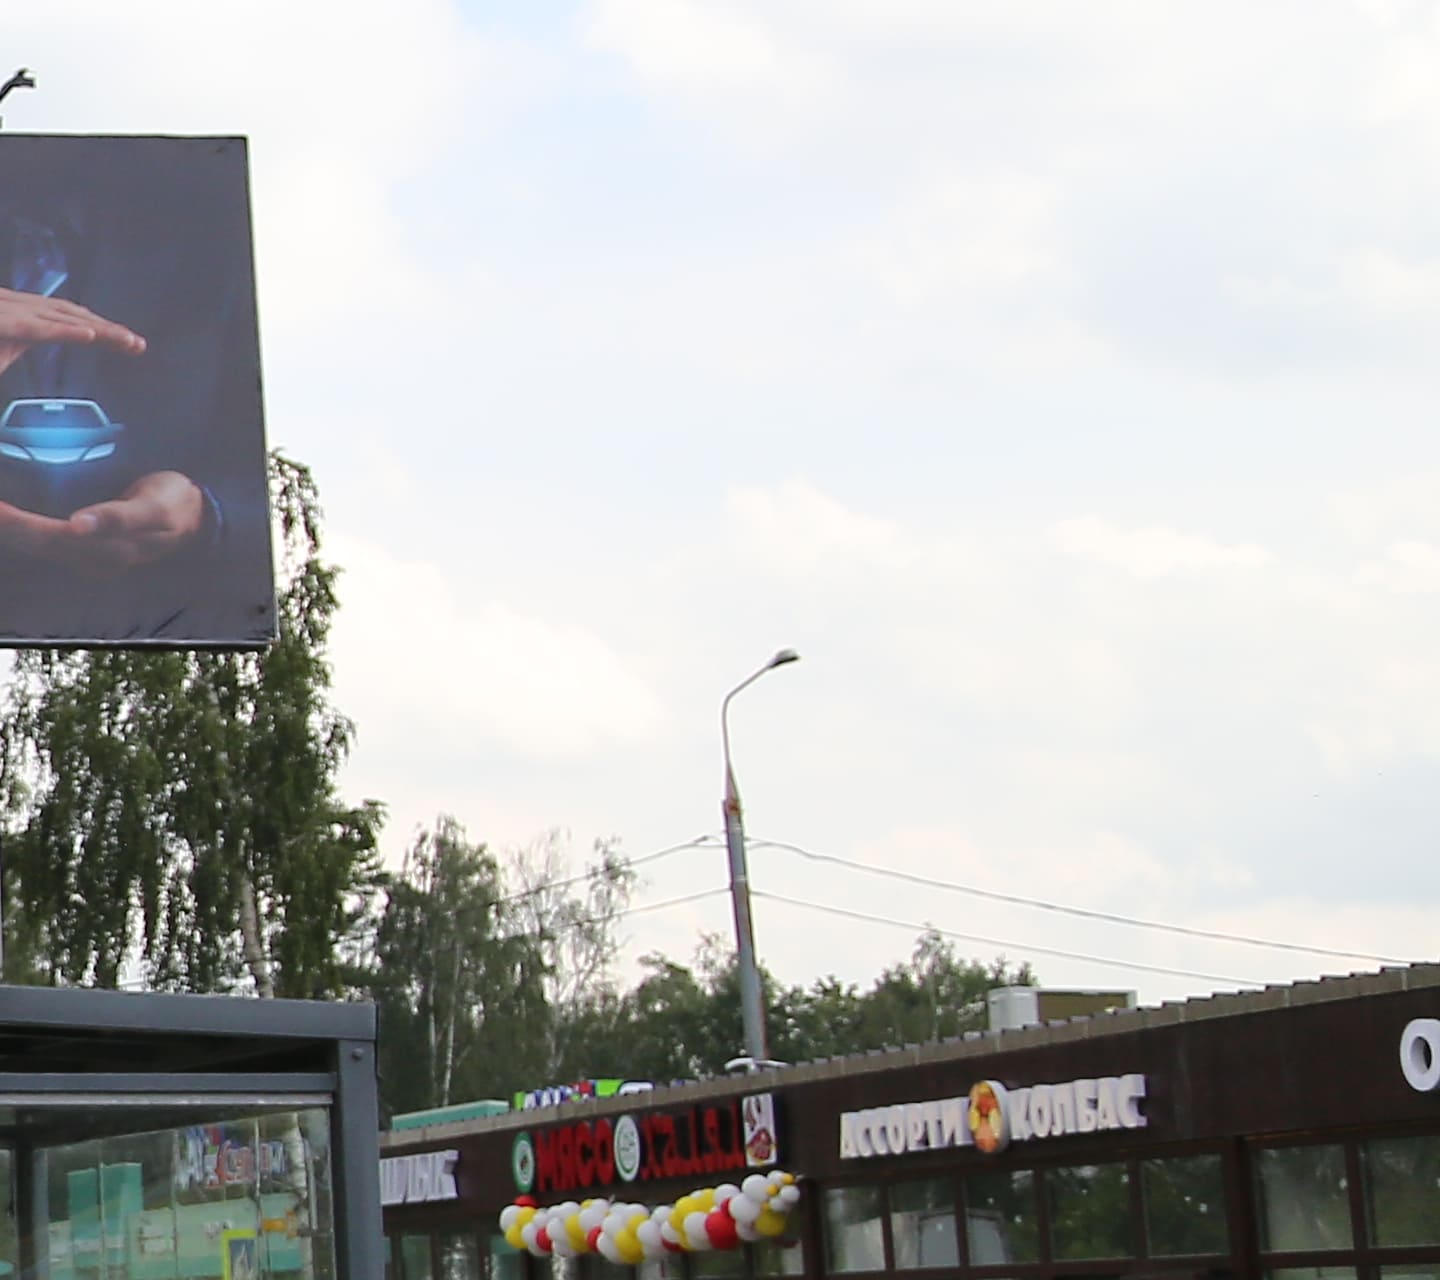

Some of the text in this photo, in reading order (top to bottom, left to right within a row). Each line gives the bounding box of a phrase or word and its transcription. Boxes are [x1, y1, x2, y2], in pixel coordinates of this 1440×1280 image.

[535, 1118, 616, 1192] МЯСО
[840, 1074, 1148, 1159] АССОРТИ КОЛБАС
